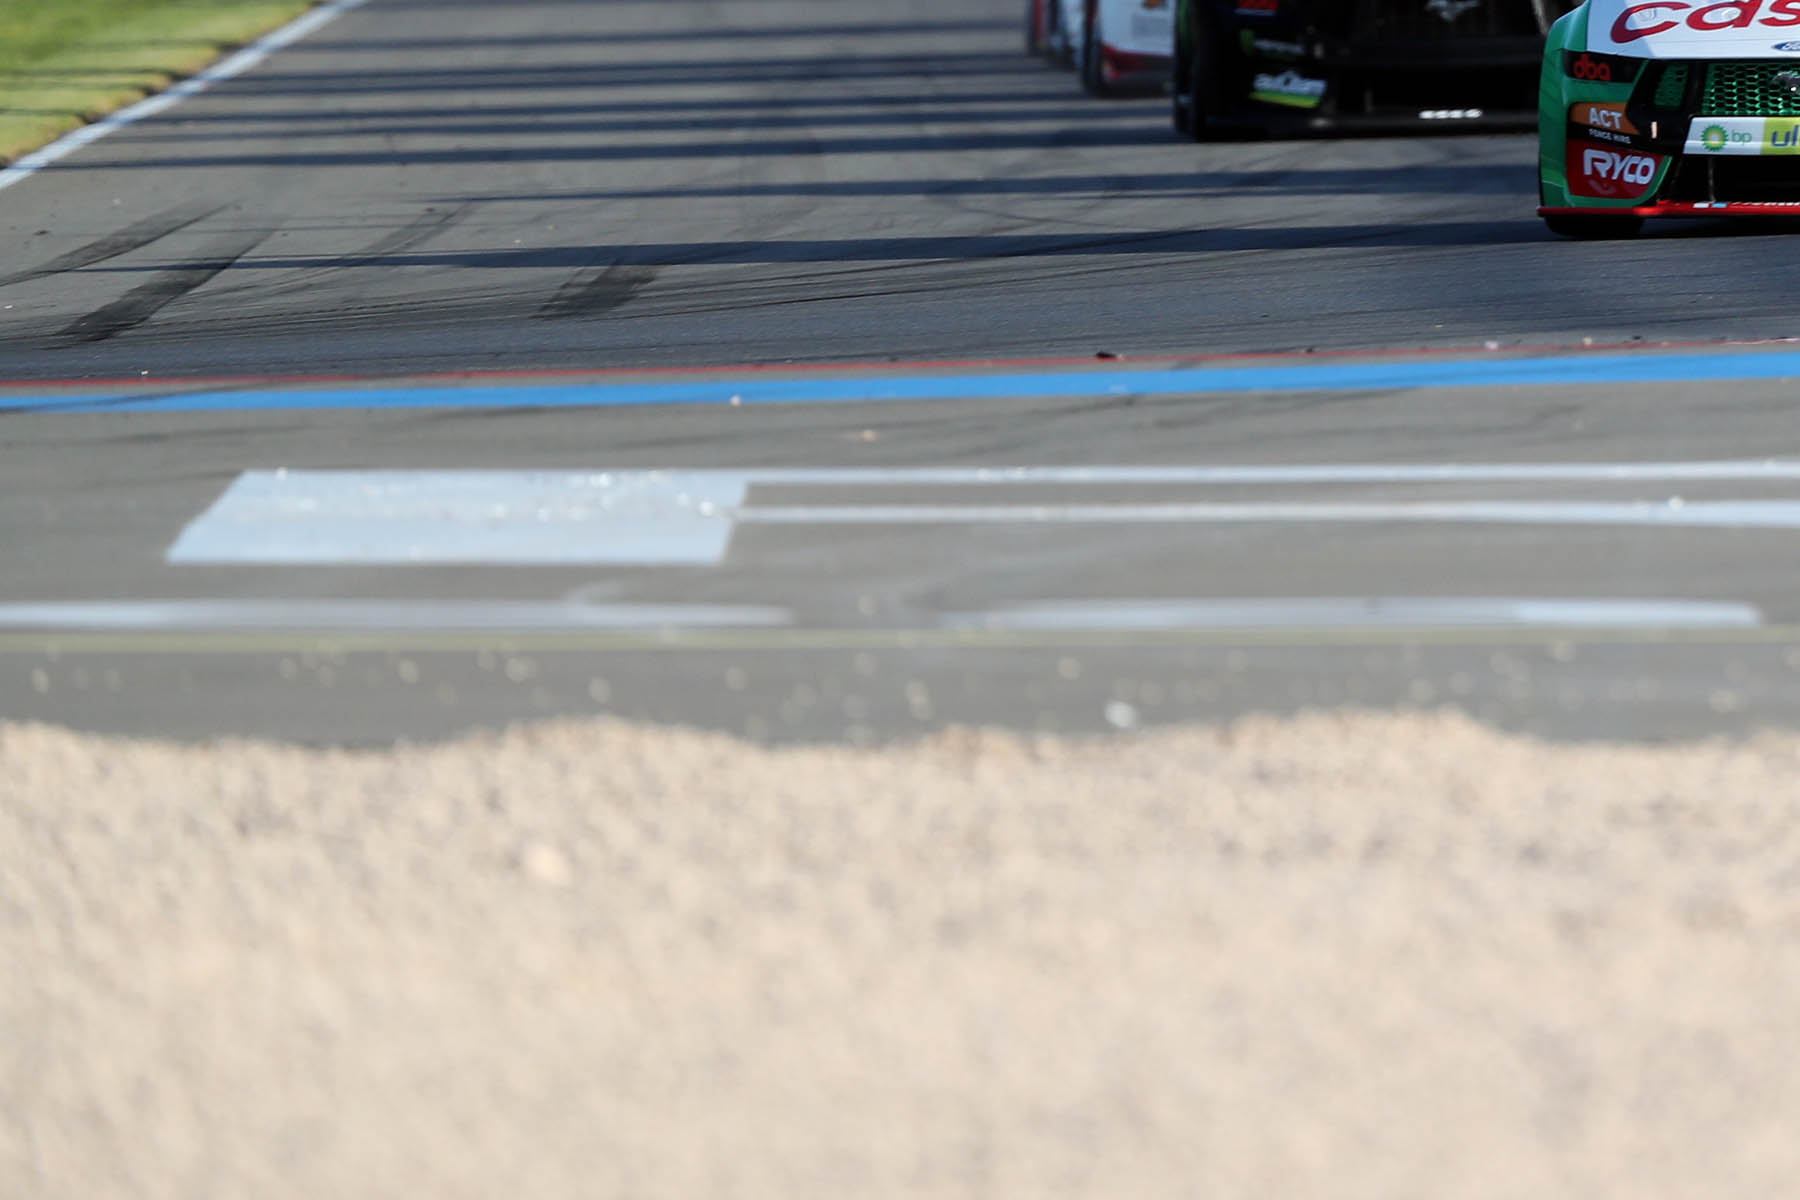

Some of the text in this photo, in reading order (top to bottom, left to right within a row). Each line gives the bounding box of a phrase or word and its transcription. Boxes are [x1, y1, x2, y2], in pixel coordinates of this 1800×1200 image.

[1573, 54, 1611, 81] dba
[1588, 107, 1623, 130] ACT
[1731, 129, 1753, 144] bp
[1583, 148, 1656, 185] RYCO
